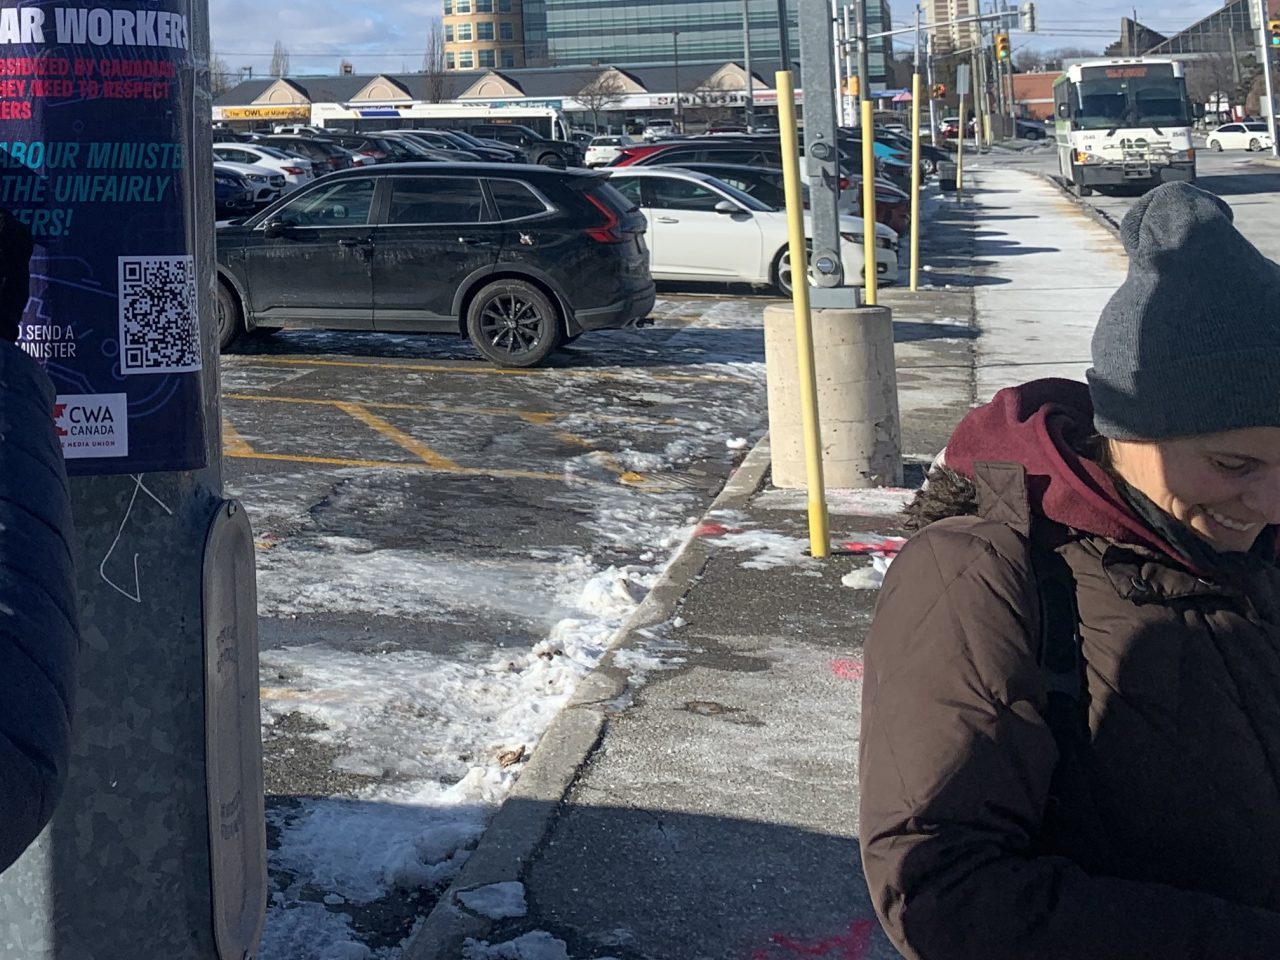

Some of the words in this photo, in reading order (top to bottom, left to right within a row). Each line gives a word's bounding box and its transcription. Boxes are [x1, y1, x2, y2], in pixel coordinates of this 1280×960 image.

[74, 59, 95, 76] BY
[30, 79, 73, 97] NEED
[78, 80, 99, 97] TO
[103, 80, 170, 99] RESPECT
[2, 175, 49, 202] THE
[55, 175, 171, 202] UNFAIRLY
[26, 325, 62, 340] SEND
[65, 325, 74, 340] A
[69, 406, 114, 423] CWA
[70, 425, 114, 435] CANADA
